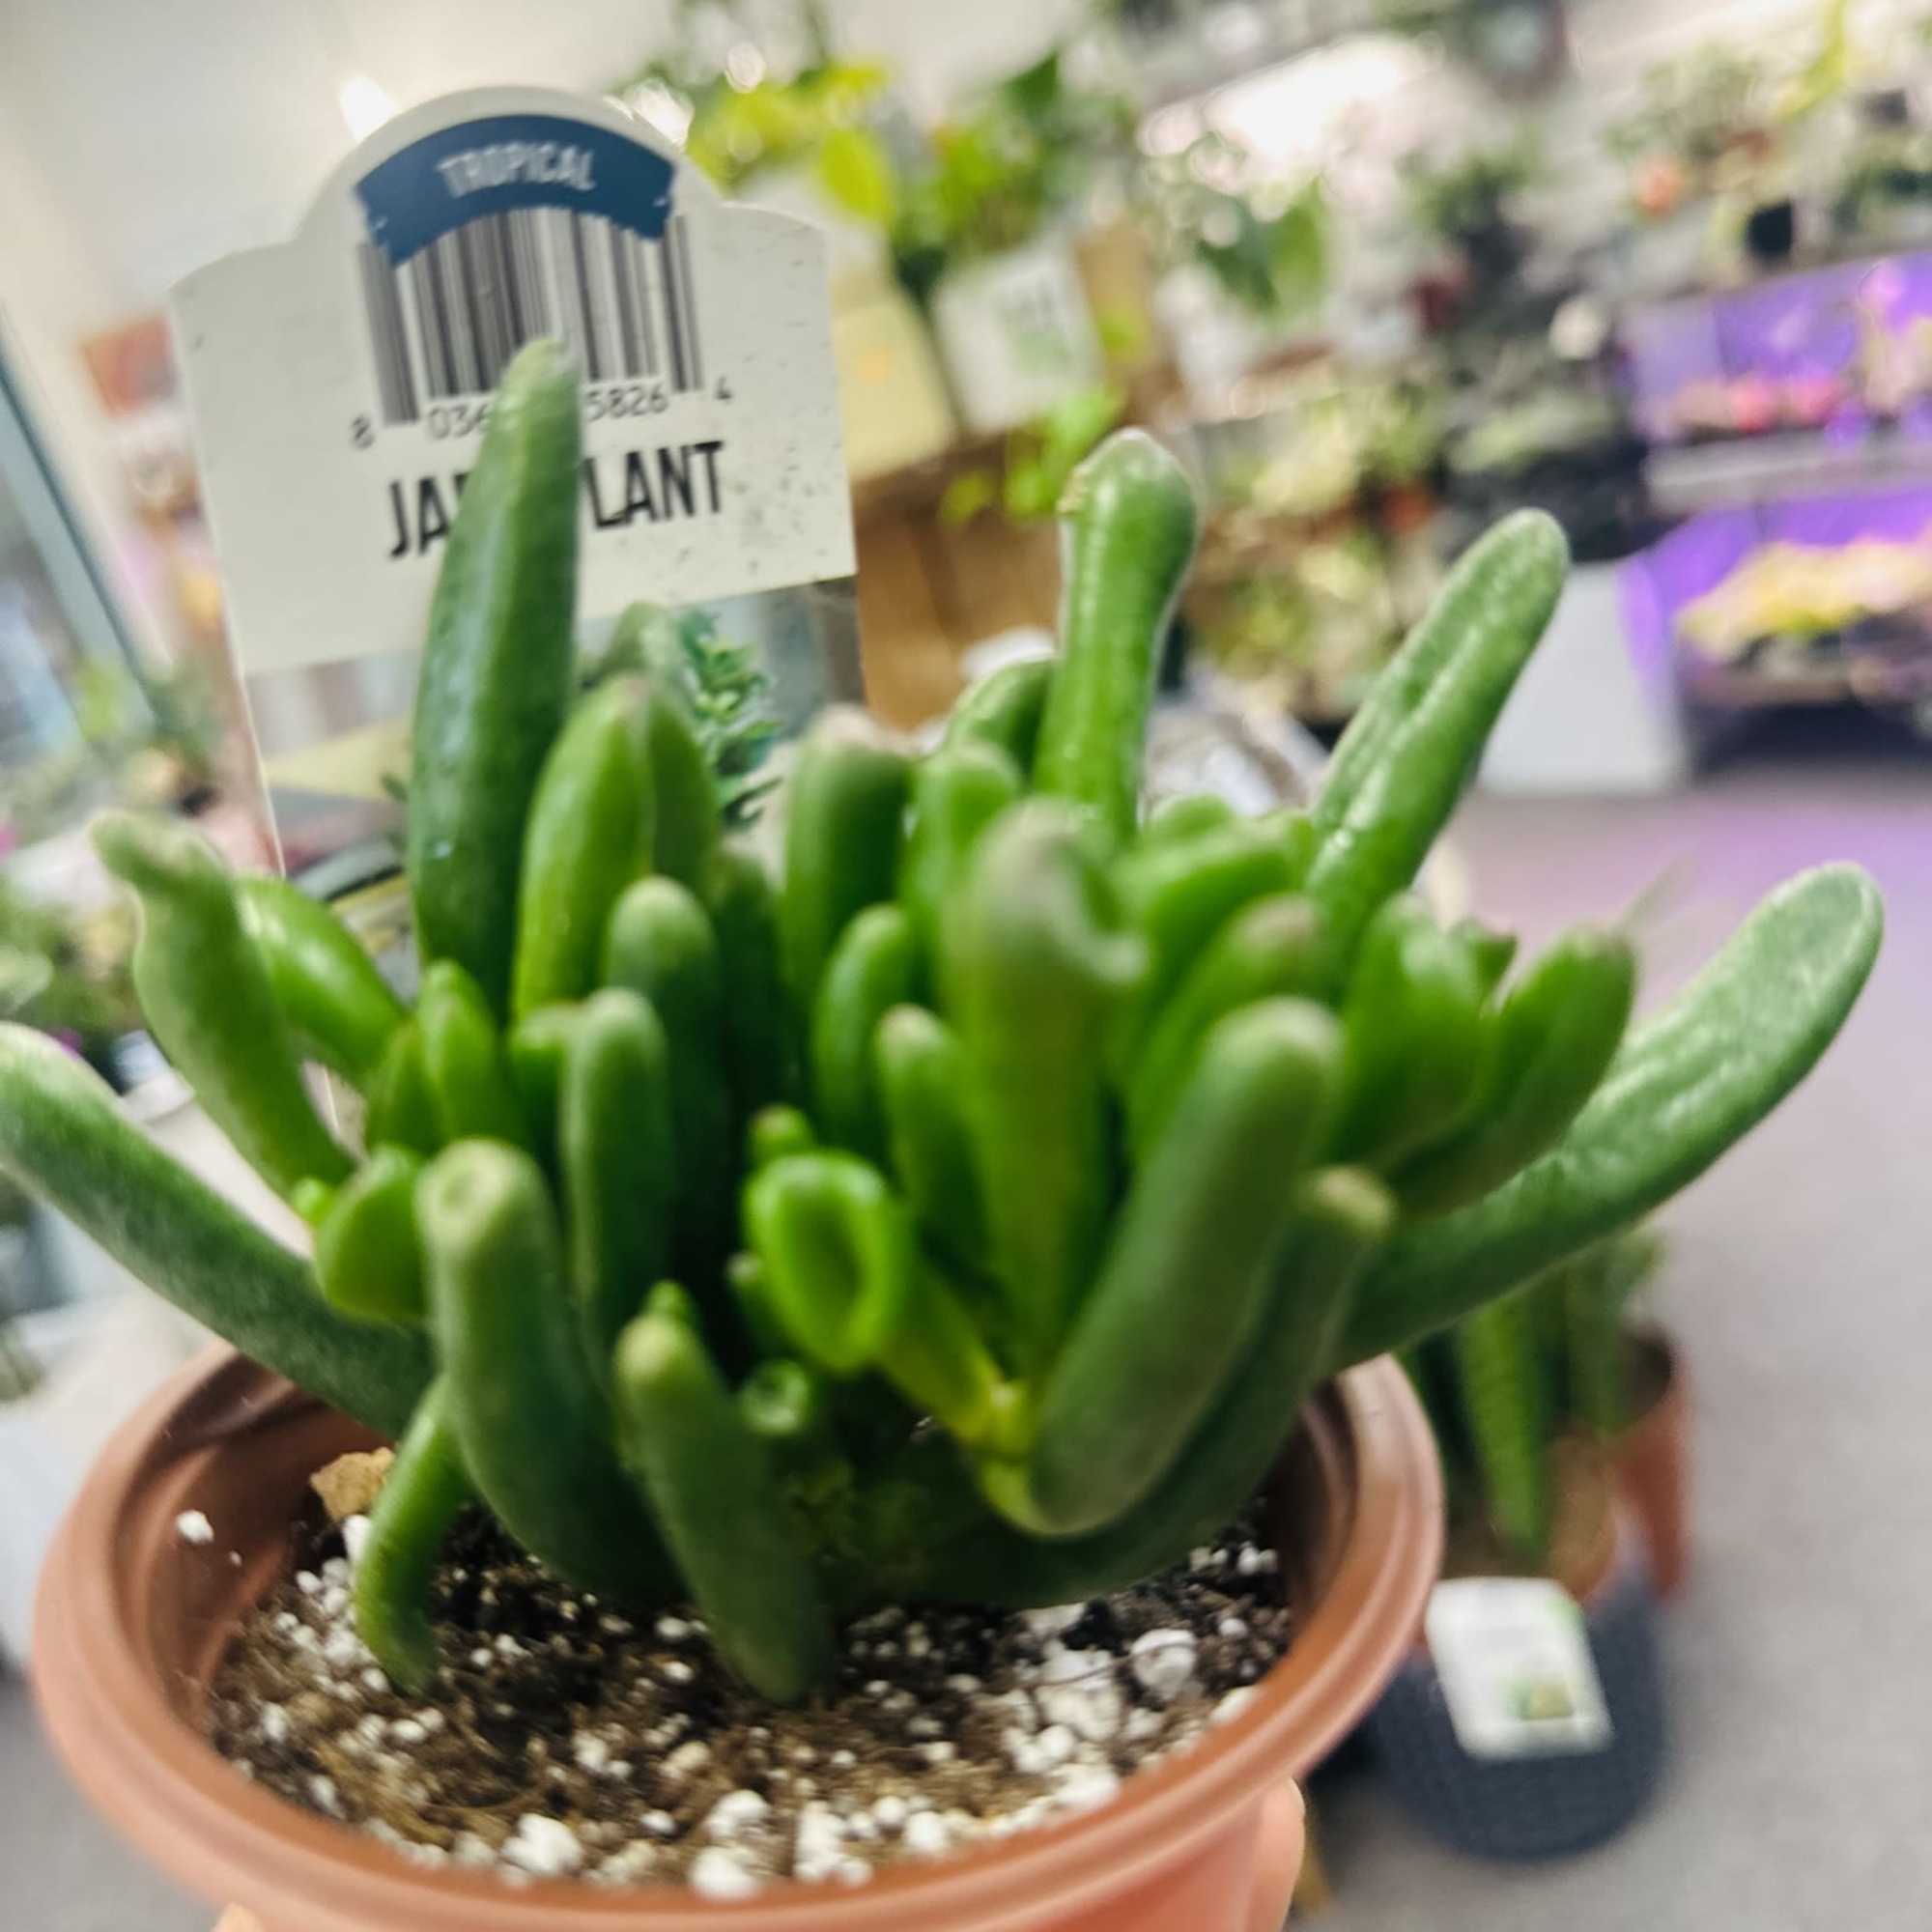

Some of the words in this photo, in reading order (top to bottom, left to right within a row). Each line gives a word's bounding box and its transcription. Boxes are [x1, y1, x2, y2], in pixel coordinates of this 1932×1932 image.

[436, 141, 596, 198] TROPICAL
[352, 415, 375, 450] 8
[584, 383, 668, 422] 5826
[715, 376, 733, 402] 4
[389, 471, 469, 559] JA
[582, 440, 724, 530] LANT
